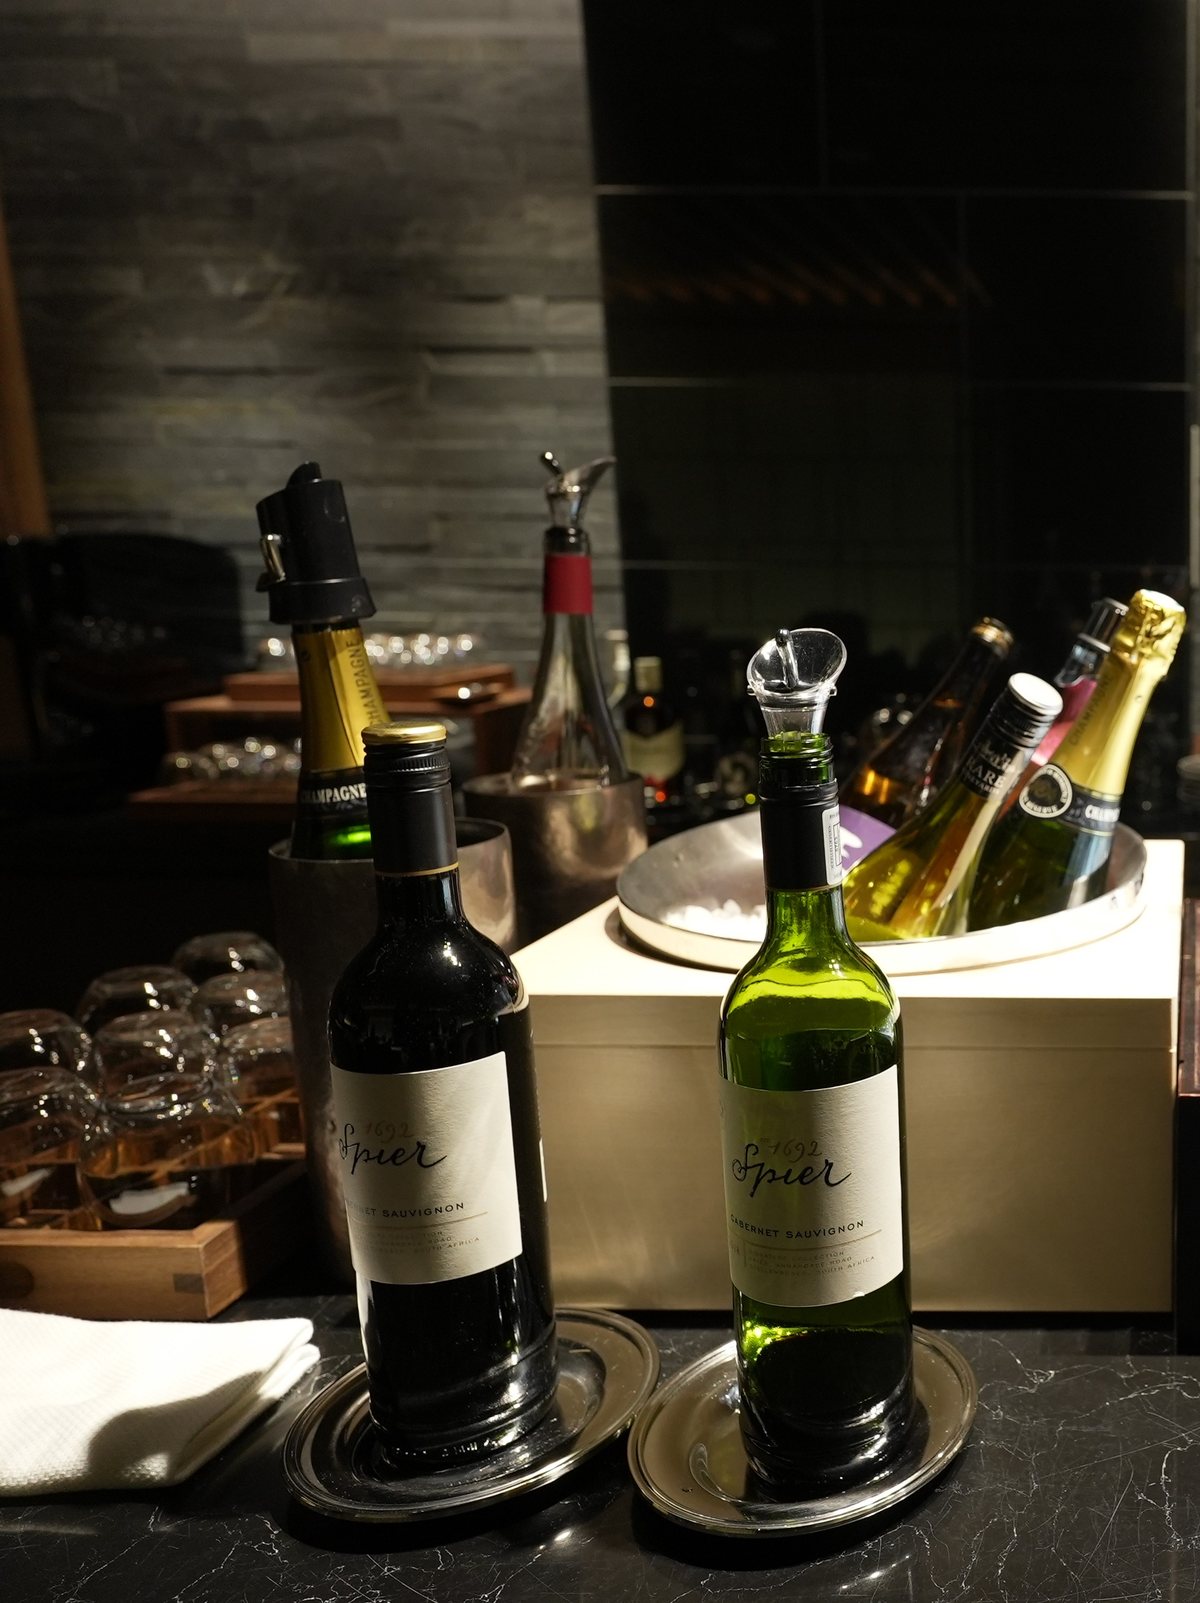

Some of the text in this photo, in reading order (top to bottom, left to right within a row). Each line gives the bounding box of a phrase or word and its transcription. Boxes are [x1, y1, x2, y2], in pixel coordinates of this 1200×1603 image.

[339, 1123, 448, 1175] Spier
[768, 1140, 822, 1163] 1692
[732, 1143, 852, 1198] Spier
[382, 1202, 465, 1218] SAUVIGNON
[730, 1213, 865, 1239] CABERNET SAUVIGNON
